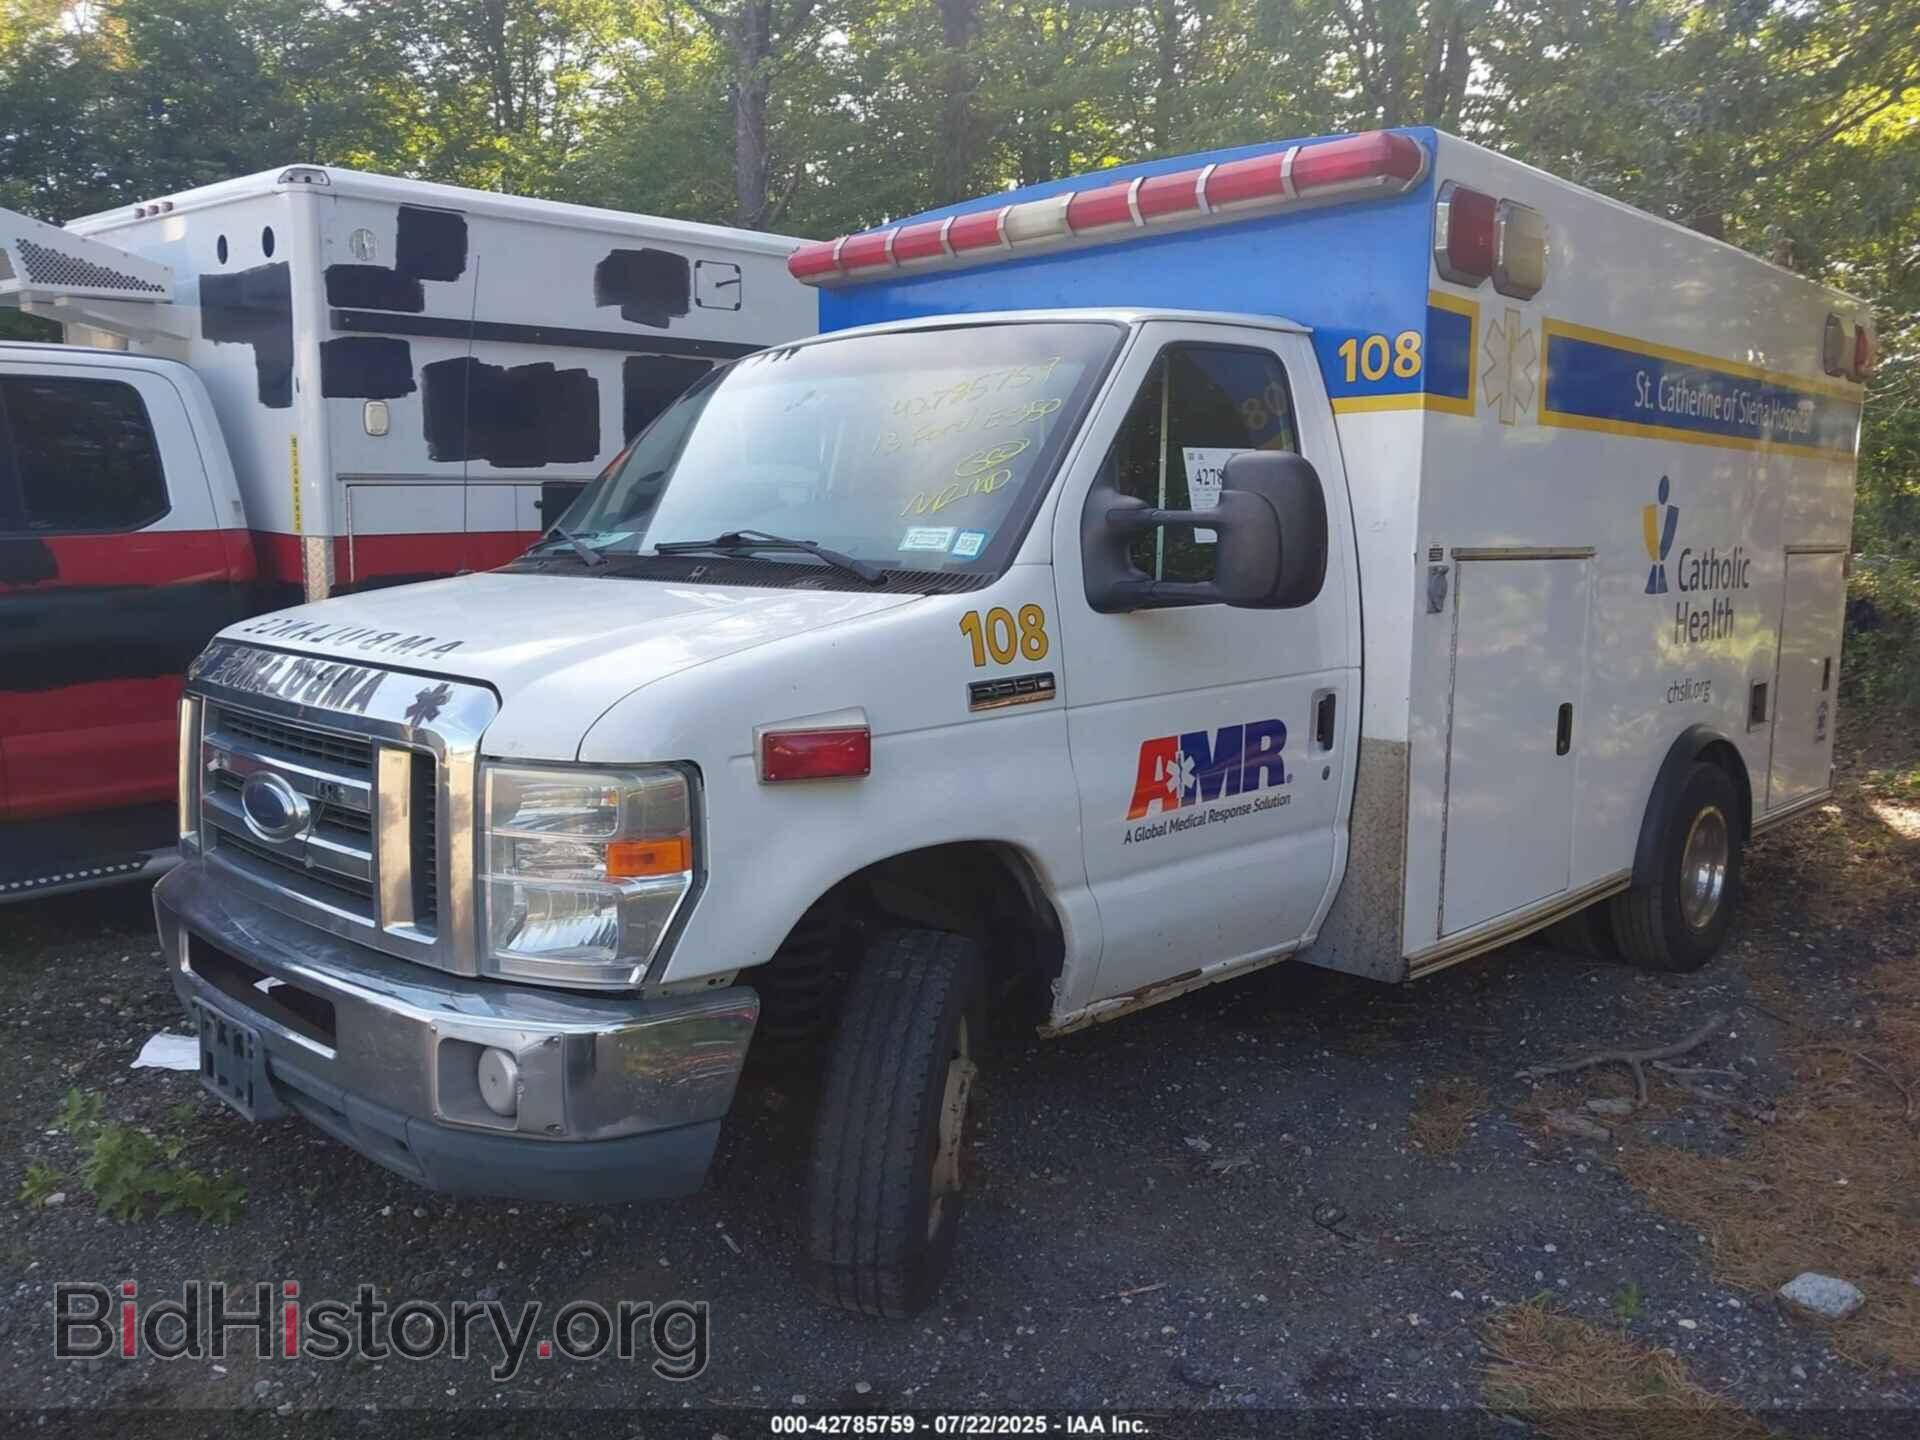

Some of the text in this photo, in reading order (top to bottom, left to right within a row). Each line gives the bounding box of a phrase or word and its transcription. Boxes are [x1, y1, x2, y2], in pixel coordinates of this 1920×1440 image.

[1337, 330, 1422, 383] 108
[1634, 370, 1654, 409] St.
[1658, 375, 1721, 420] Catherine
[1723, 389, 1738, 424] of
[1677, 547, 1750, 592] Catholic
[959, 603, 1049, 667] 108
[1674, 598, 1734, 644] Health
[1667, 678, 1711, 704] chsli.org
[1124, 793, 1291, 845] A Global Medical Response Solution
